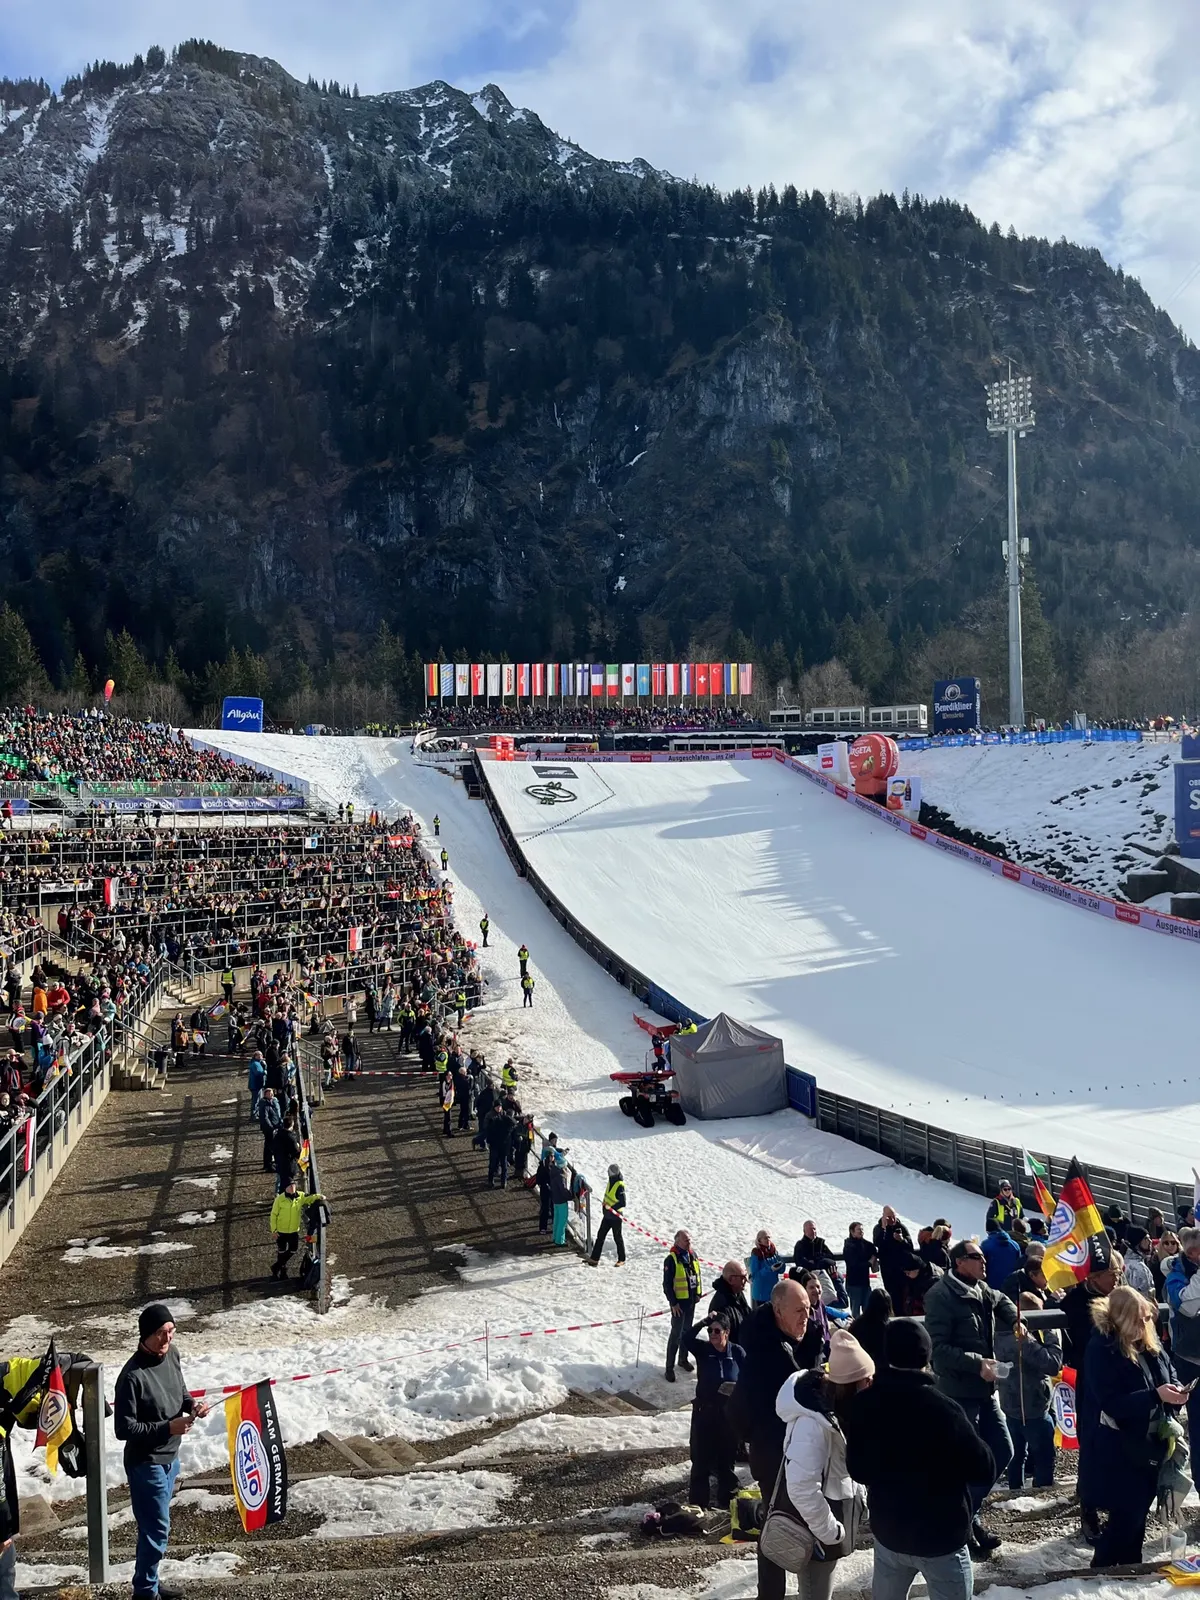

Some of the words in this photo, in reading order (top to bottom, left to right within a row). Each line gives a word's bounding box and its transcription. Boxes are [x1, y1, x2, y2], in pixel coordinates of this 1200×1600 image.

[226, 708, 261, 724] Allgäu
[668, 753, 710, 762] Ausgeschlafen
[725, 752, 736, 760] Ziel
[1031, 877, 1072, 900] Ausgeschlafen
[1077, 894, 1087, 906] ins
[1088, 898, 1100, 910] Ziel
[264, 1400, 277, 1440] TEAM
[271, 1443, 282, 1516] GERMANY
